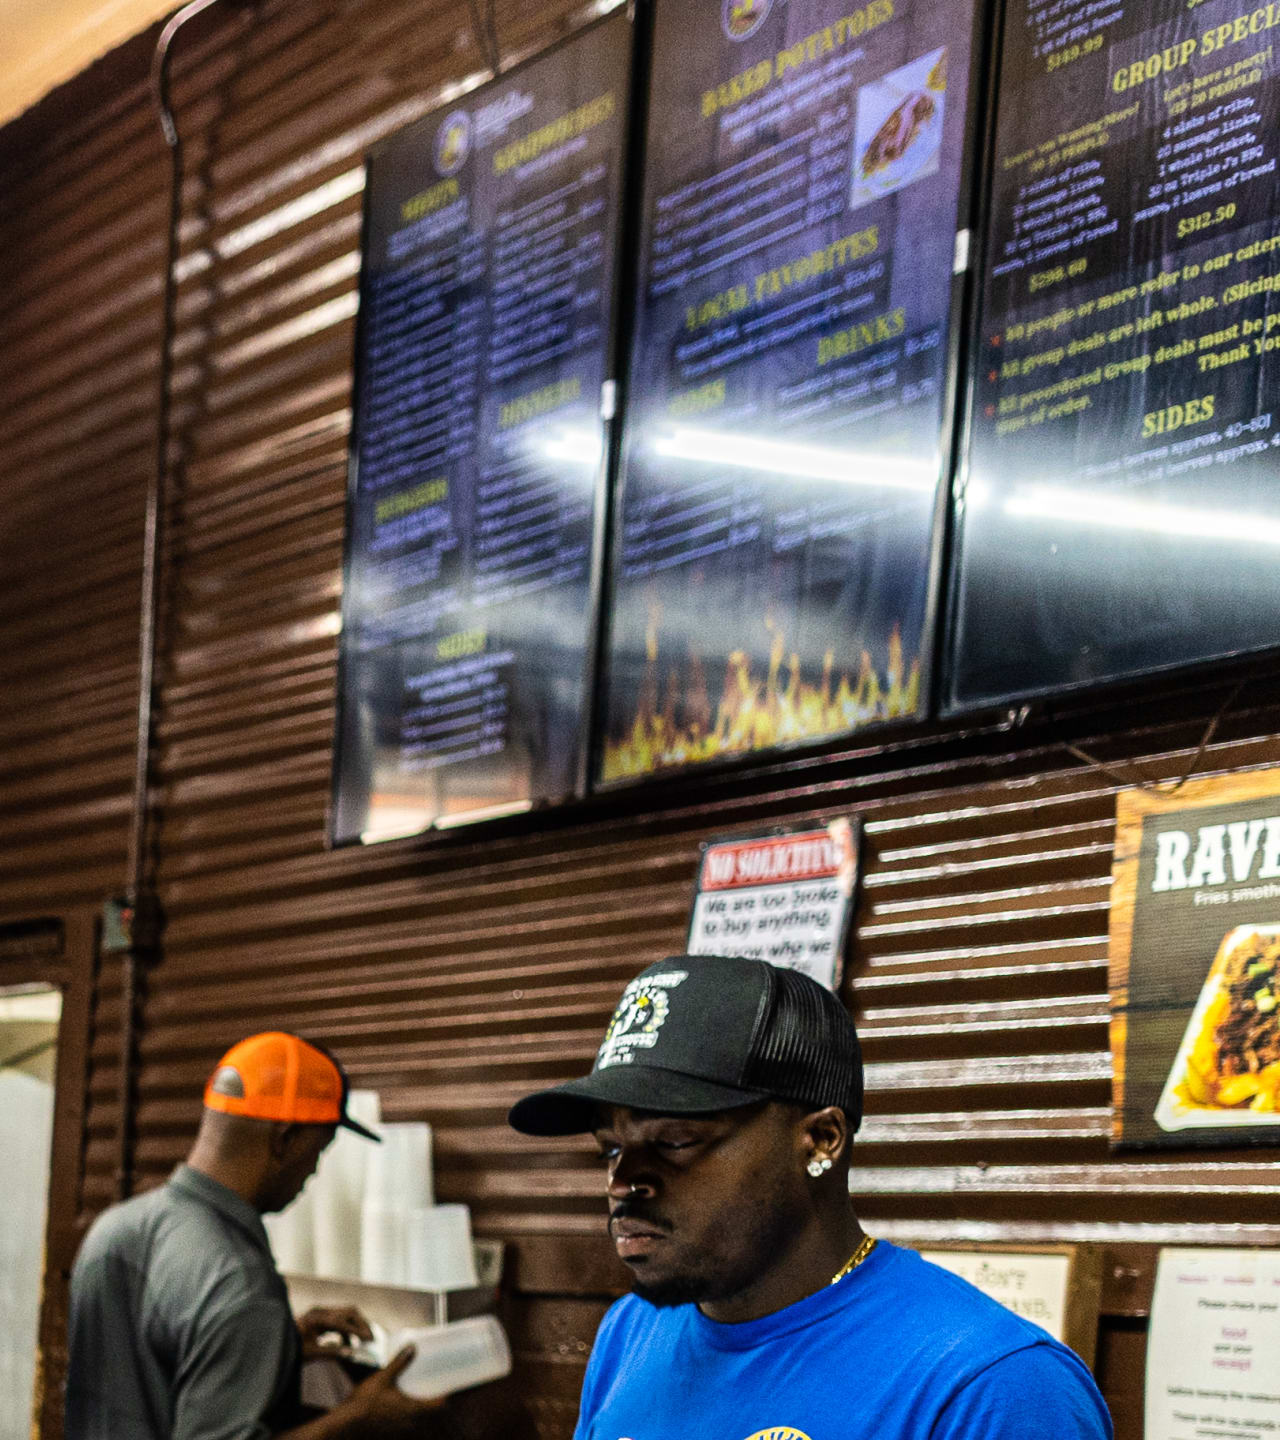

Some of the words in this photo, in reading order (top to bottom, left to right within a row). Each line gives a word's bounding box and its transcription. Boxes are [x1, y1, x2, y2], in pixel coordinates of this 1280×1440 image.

[1112, 38, 1197, 93] GROUP
[1207, 105, 1223, 121] of
[1140, 271, 1180, 296] refer
[1182, 264, 1200, 281] to
[1202, 252, 1234, 273] our
[816, 307, 906, 367] DRINKS
[1066, 333, 1106, 357] deals
[1107, 323, 1134, 343] are
[1135, 311, 1163, 335] left
[1166, 296, 1219, 322] whole.
[1154, 339, 1197, 363] deals
[1198, 323, 1239, 350] must
[1242, 318, 1263, 335] be
[1198, 342, 1250, 372] Thank
[1142, 394, 1216, 439] SIDES
[709, 851, 734, 883] NO
[1194, 890, 1229, 907] Fries
